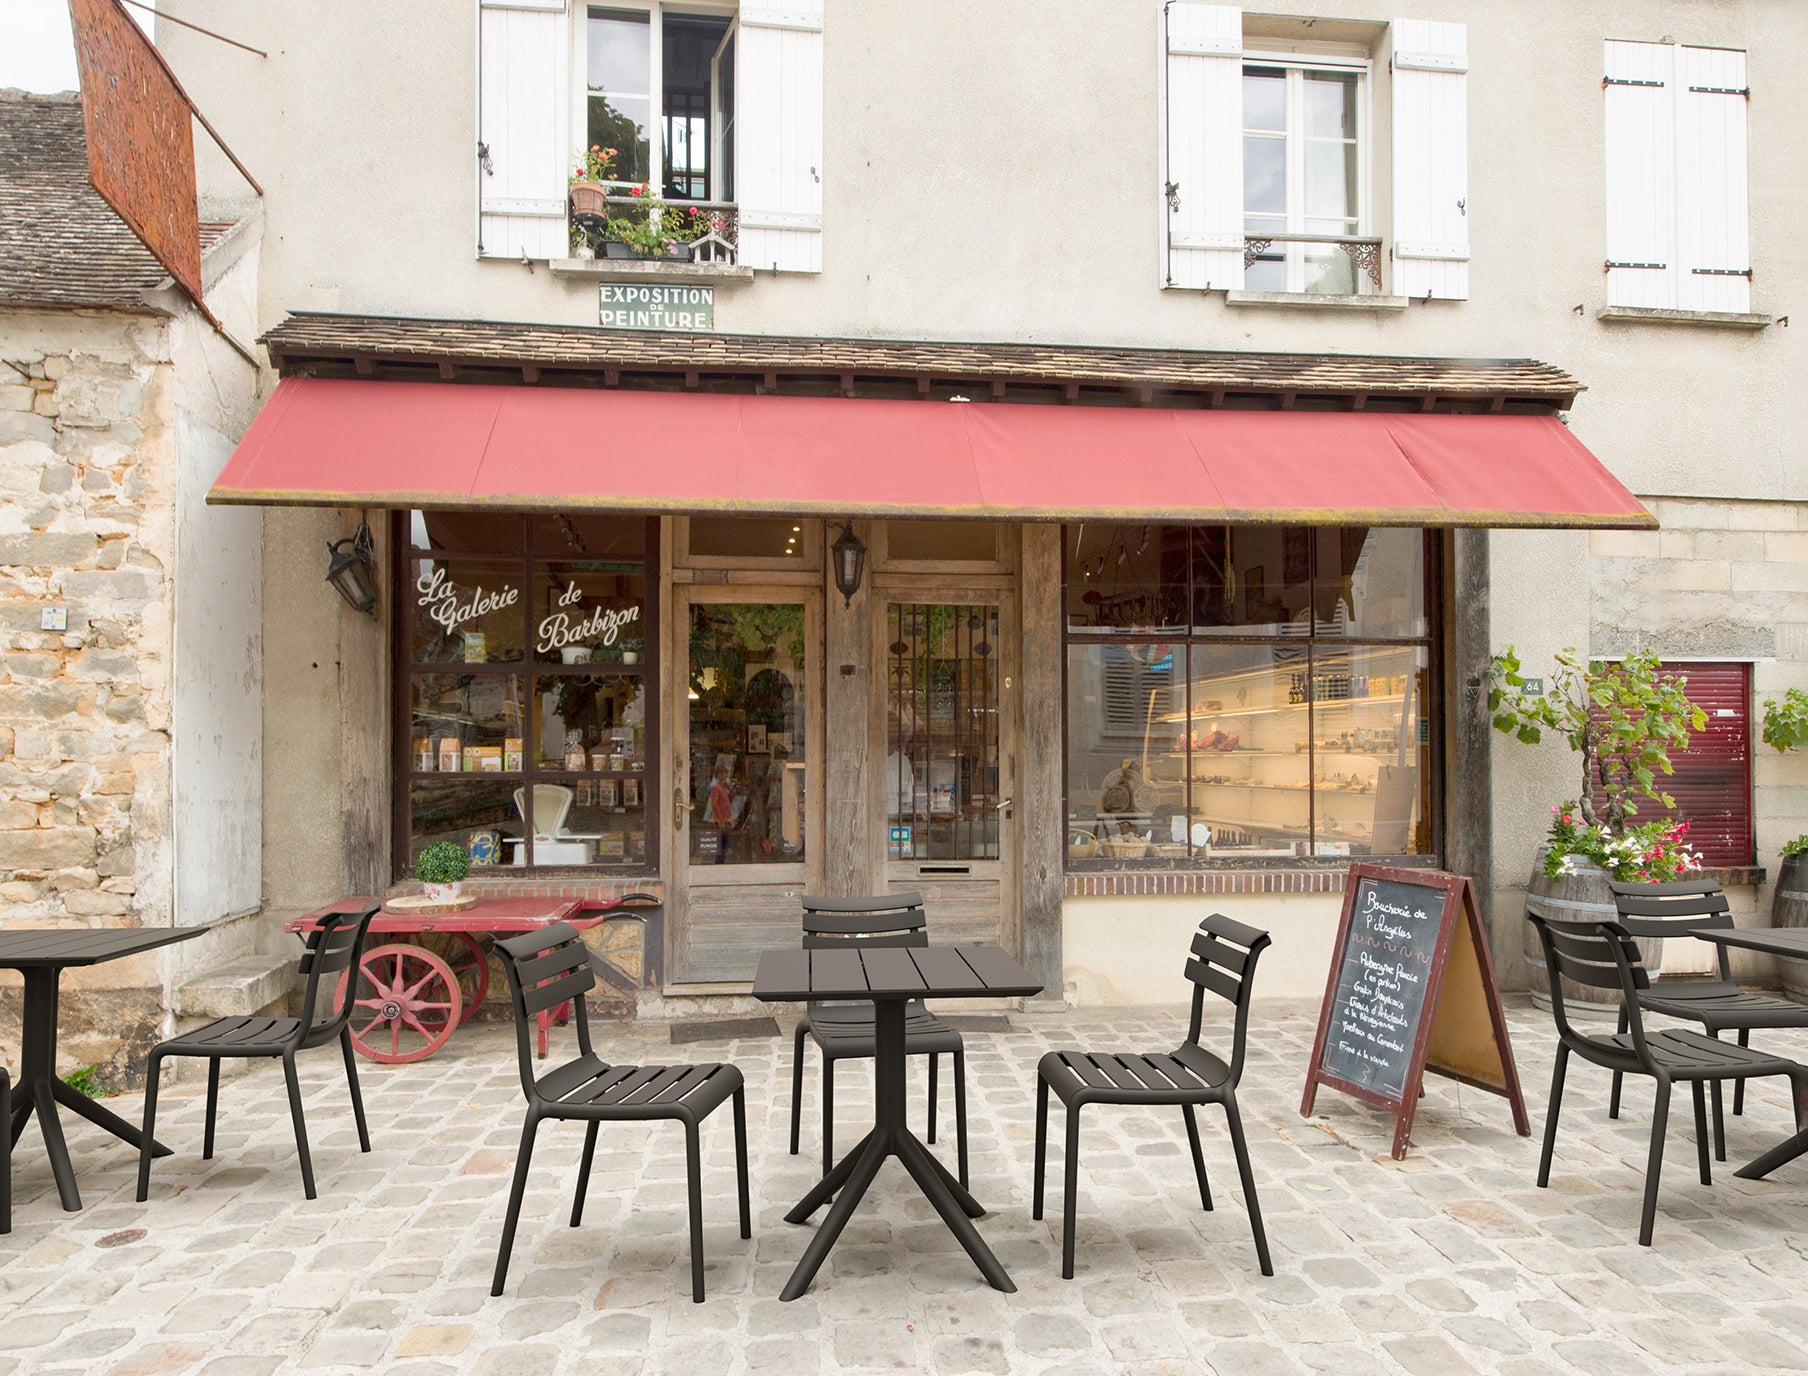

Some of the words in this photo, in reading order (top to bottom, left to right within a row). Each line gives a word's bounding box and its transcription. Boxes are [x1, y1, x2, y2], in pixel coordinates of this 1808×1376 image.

[600, 286, 713, 305] EXPOSITION
[650, 303, 664, 311] DE
[600, 310, 707, 328] PEINTURE
[416, 568, 456, 606] La
[558, 580, 582, 607] de
[430, 585, 519, 635] Galerie
[536, 606, 640, 654] Barbizon
[1526, 682, 1539, 691] 64
[1362, 891, 1411, 918] Boucherie
[1414, 909, 1427, 919] de
[1360, 951, 1394, 976] Aubergine
